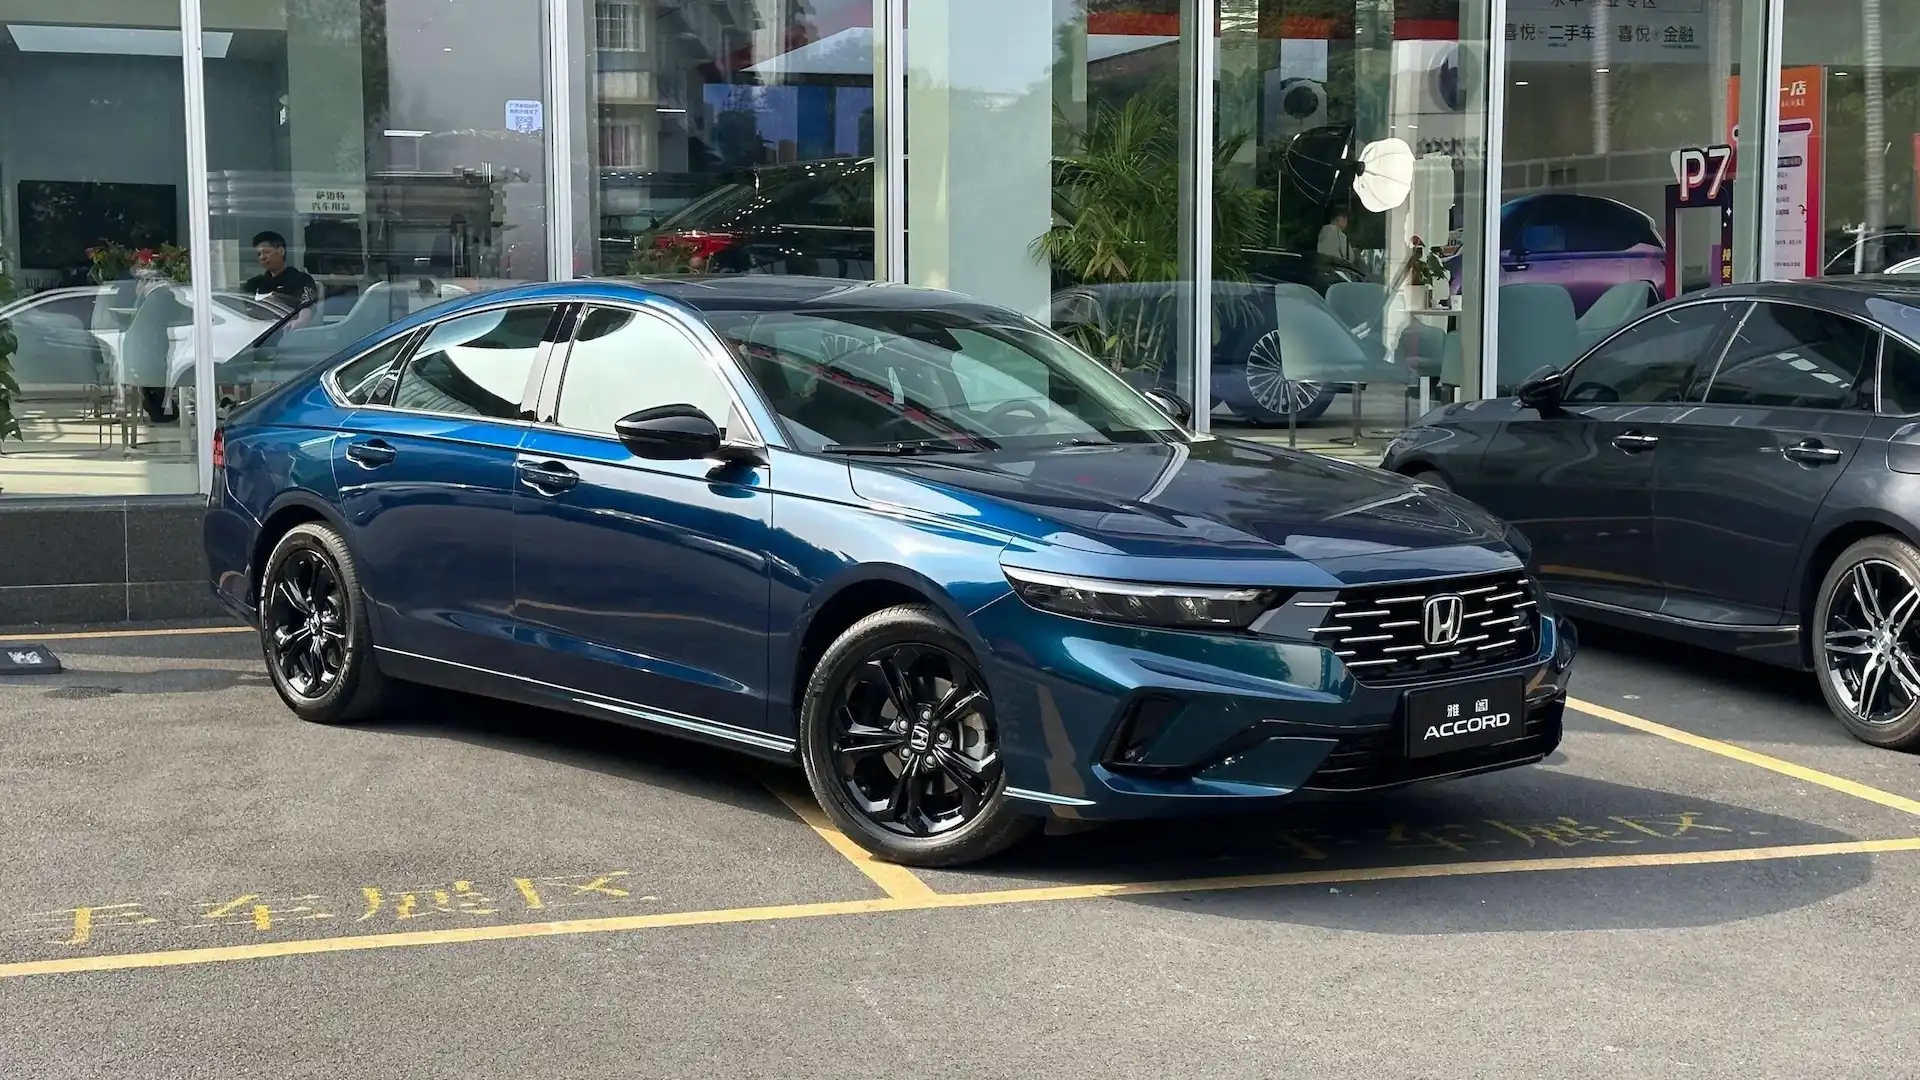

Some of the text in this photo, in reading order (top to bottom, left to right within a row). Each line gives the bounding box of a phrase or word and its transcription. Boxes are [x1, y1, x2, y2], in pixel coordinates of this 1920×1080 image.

[1548, 25, 1596, 41] 二手车
[1618, 24, 1694, 43] 喜悦 金融
[1679, 144, 1734, 201] P7
[1446, 698, 1489, 718] 雅阁
[1423, 712, 1511, 741] ACCORD
